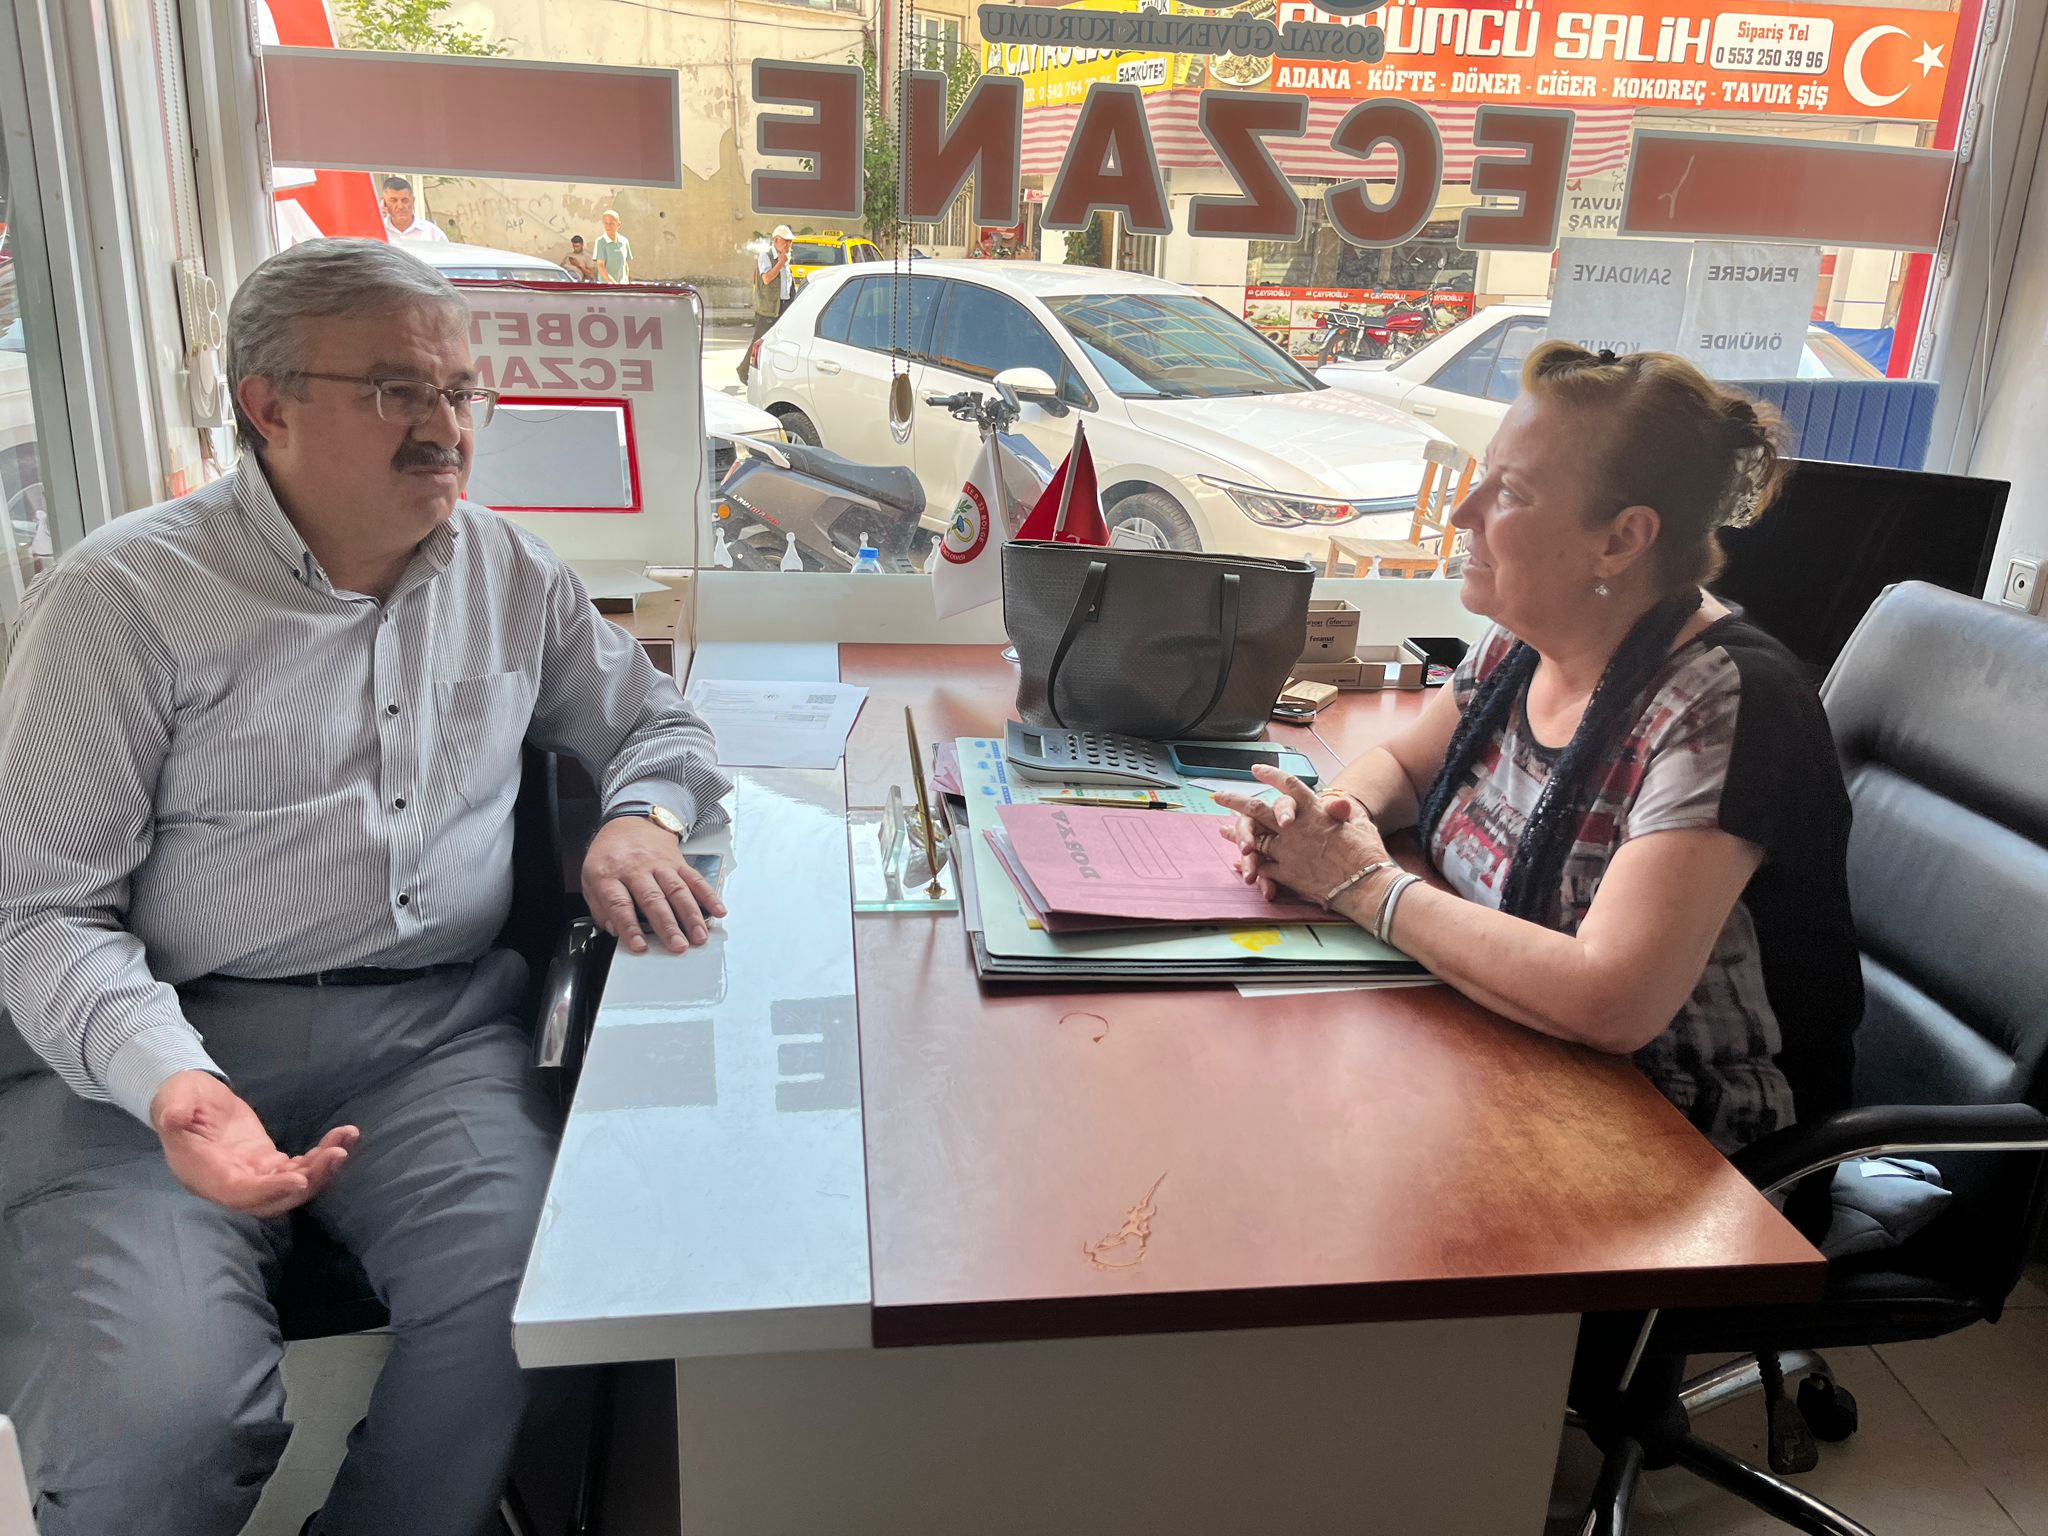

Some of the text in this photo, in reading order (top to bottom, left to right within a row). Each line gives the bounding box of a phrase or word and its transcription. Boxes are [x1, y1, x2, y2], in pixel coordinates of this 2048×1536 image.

[1737, 20, 1810, 43] Sipariş Tel
[1715, 46, 1824, 69] 0 553 250 39 96
[1276, 66, 1351, 90] ADANA
[1366, 64, 1437, 92] KÖFTE
[1450, 66, 1521, 95] DÖNER
[1536, 69, 1597, 98] CİĞER
[1611, 76, 1707, 105] KOKOREÇ
[1722, 81, 1793, 105] TAVUK
[1797, 80, 1830, 110] ŞİŞ
[1050, 809, 1102, 880] DOSYA
